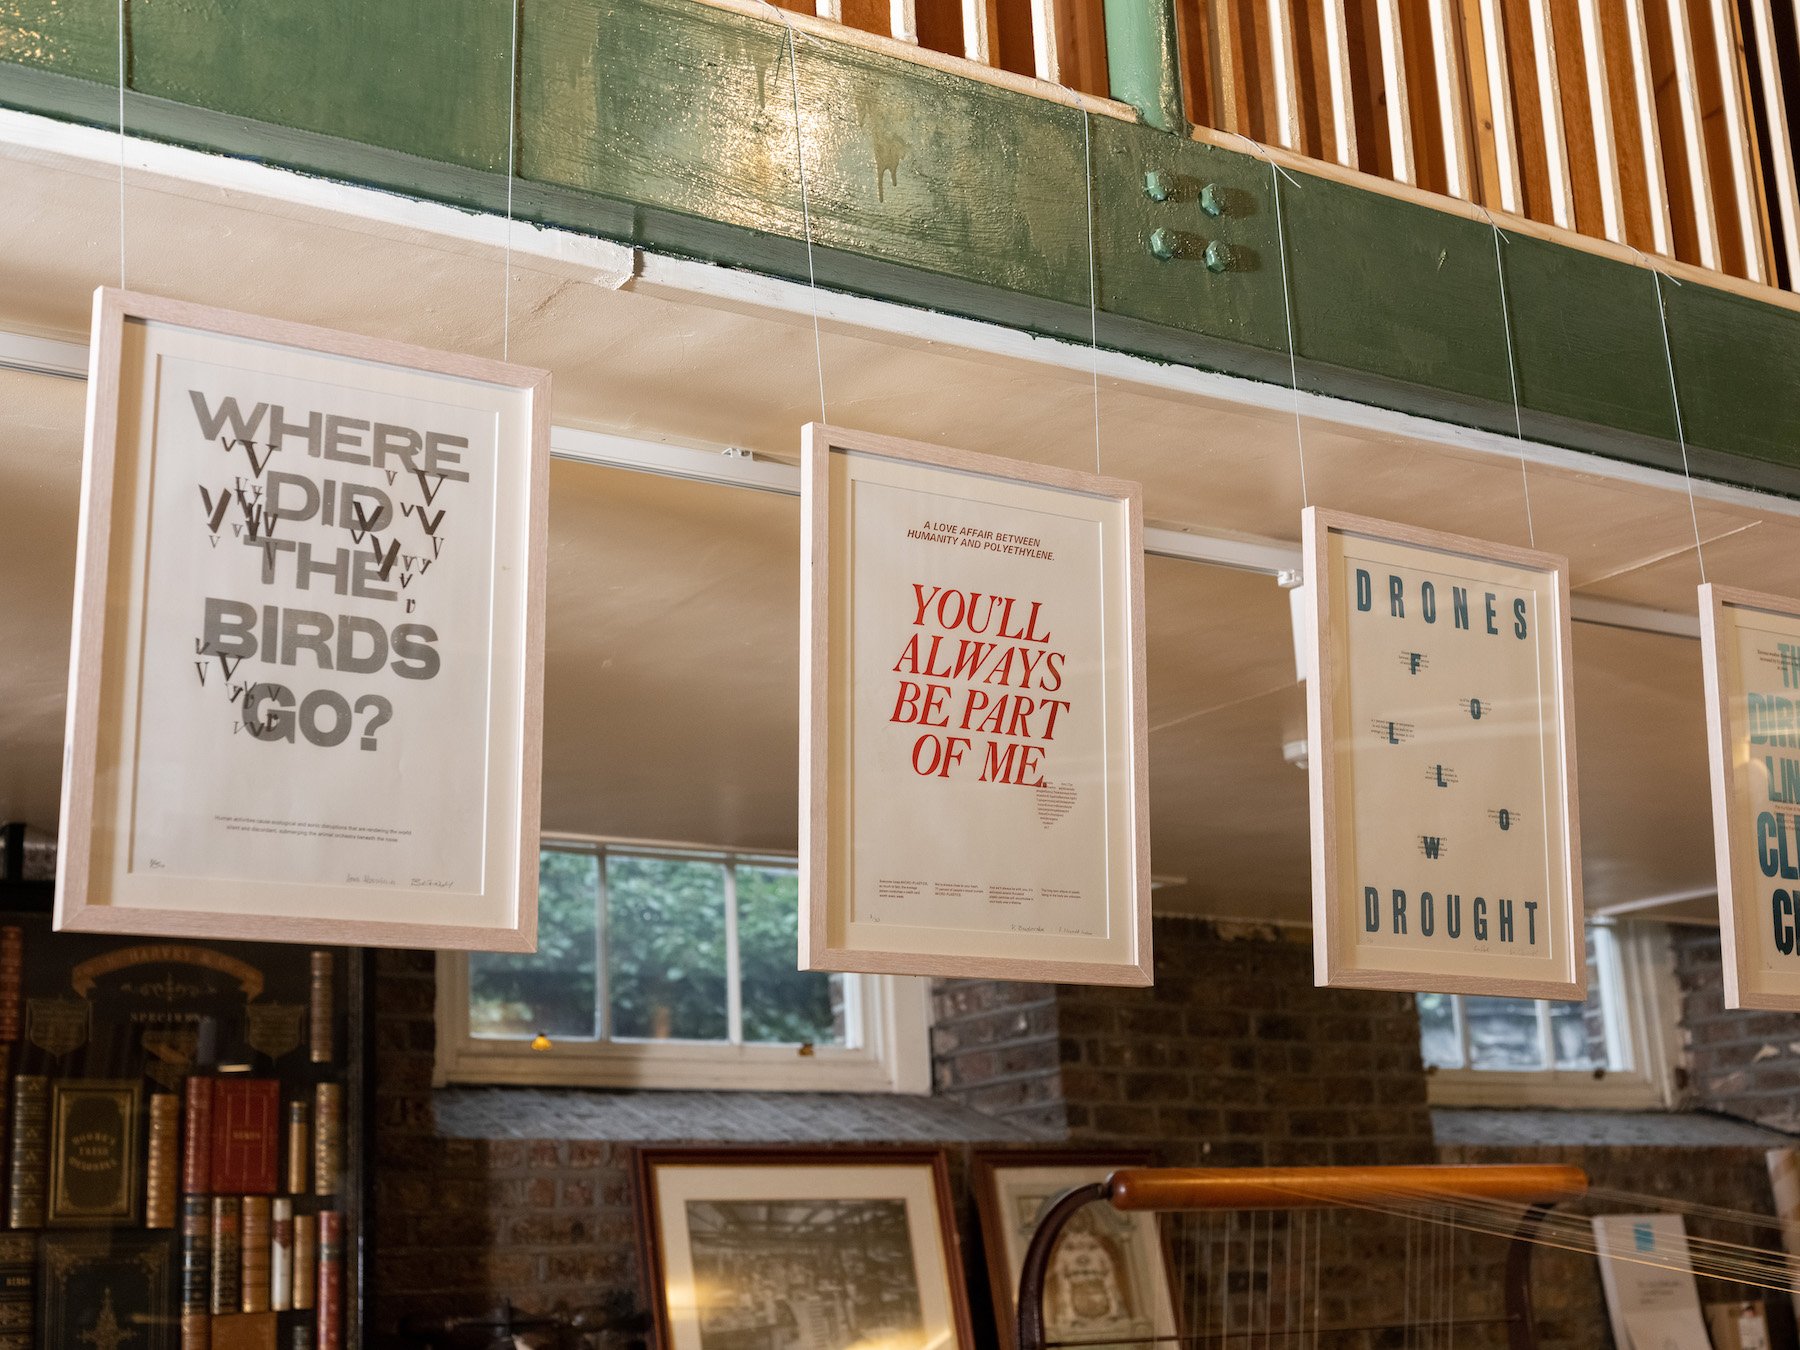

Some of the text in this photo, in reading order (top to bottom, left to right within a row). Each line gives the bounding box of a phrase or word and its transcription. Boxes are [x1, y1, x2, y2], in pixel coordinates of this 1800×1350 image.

[188, 389, 470, 483] WHERE
[265, 470, 394, 533] DID
[907, 529, 1055, 561] HUMANITY AND POLYETHYLENE.
[923, 521, 1041, 548] A LOVE AFFAIR BETWEEN
[243, 533, 398, 601] THE
[912, 583, 1051, 644] YOU'LL
[1356, 568, 1527, 640] DRONES
[204, 596, 441, 681] BIRDS
[892, 632, 1066, 692] ALWAYS
[241, 682, 393, 752] GO?
[889, 680, 1071, 741] BE PART
[1747, 692, 1800, 750] DIR
[912, 733, 972, 778] OF
[1364, 886, 1538, 945] DROUGHT
